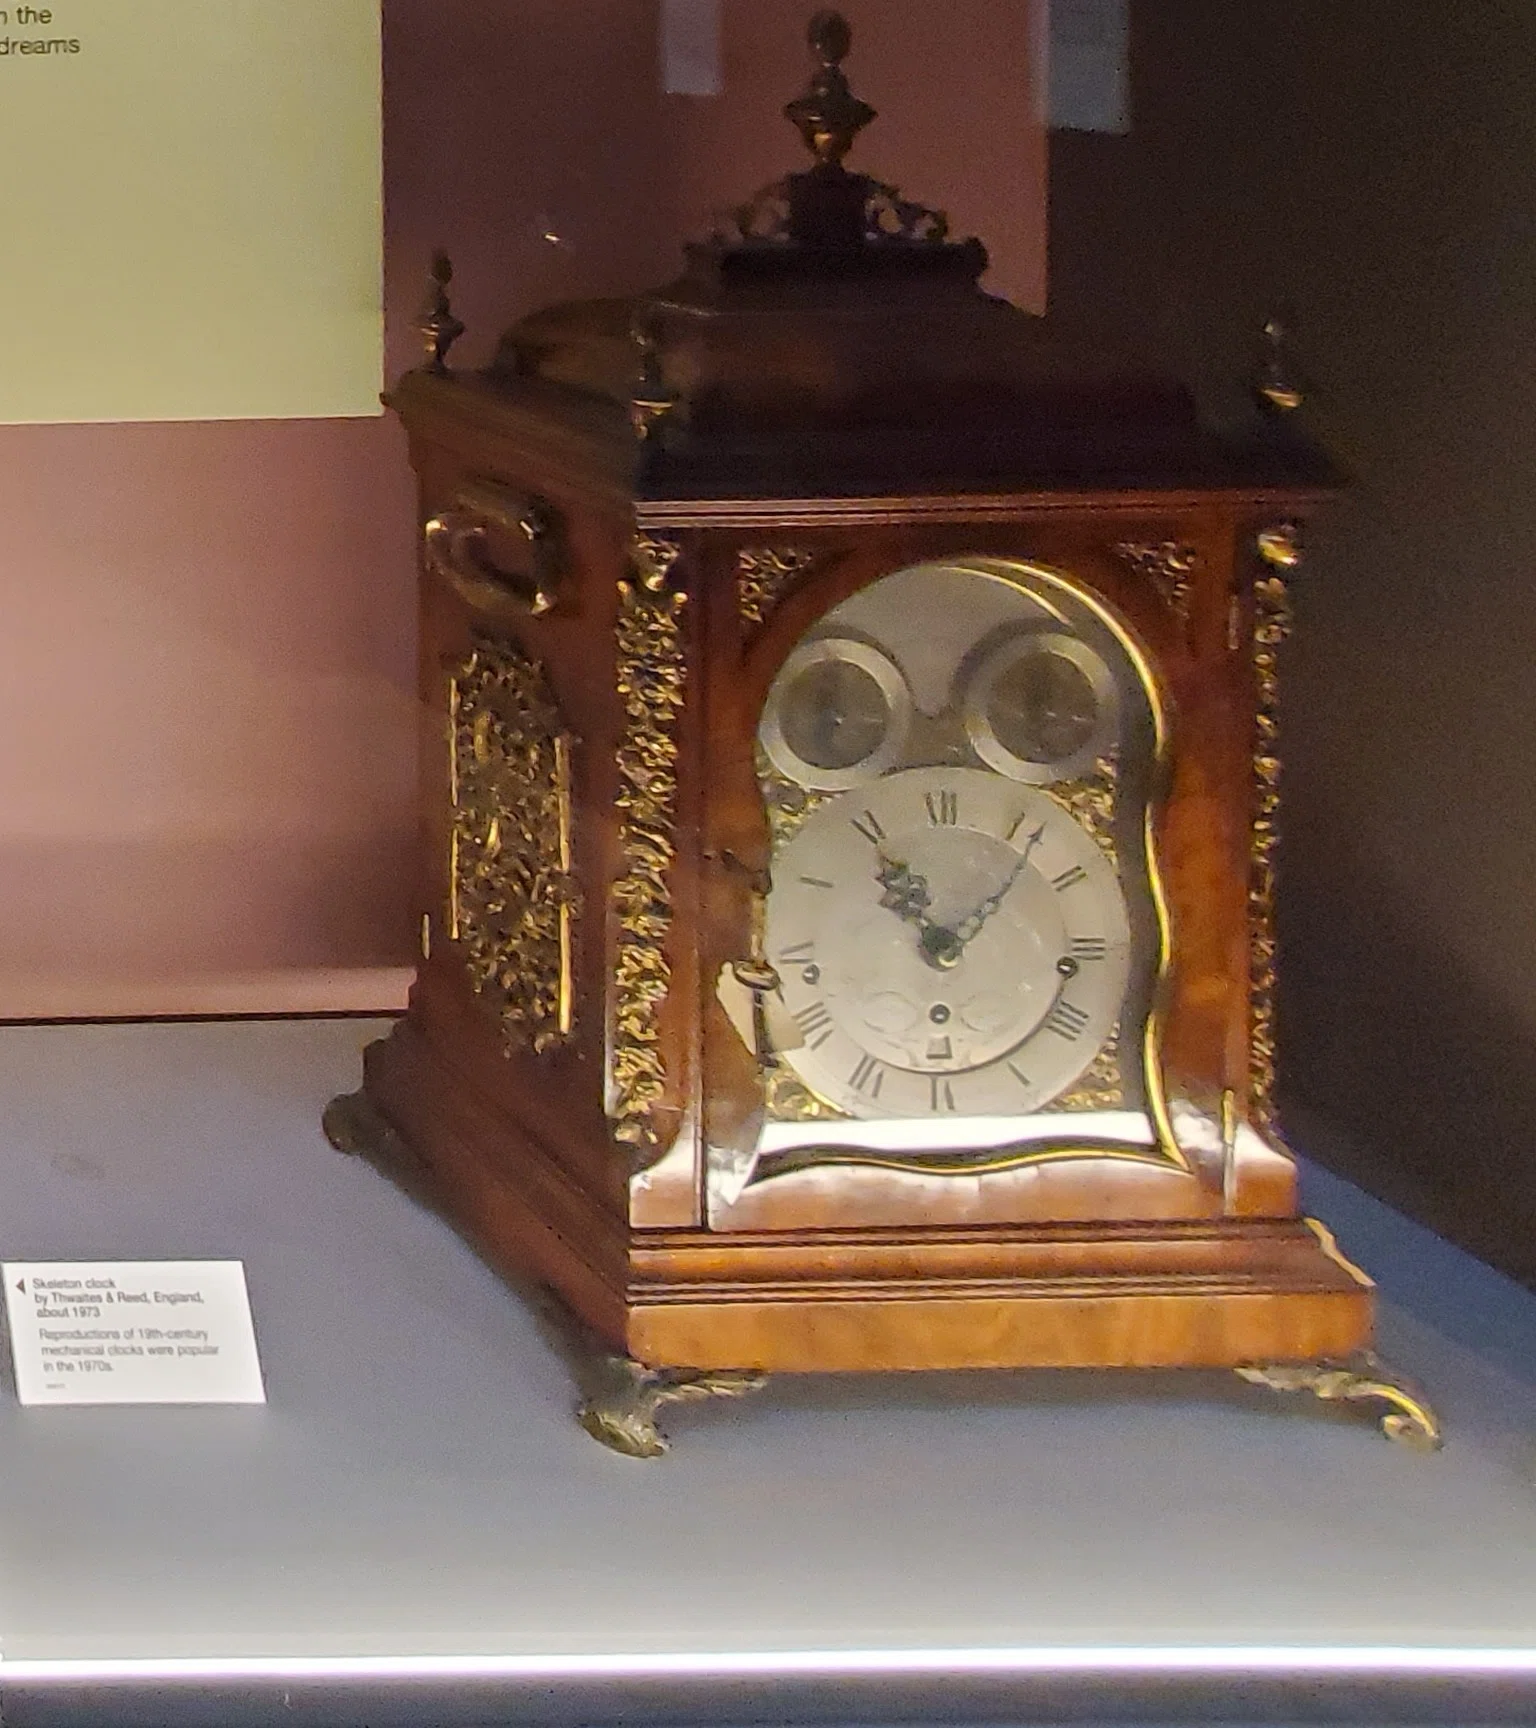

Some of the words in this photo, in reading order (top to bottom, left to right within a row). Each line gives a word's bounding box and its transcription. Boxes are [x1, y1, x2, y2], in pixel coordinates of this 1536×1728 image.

[17, 6, 53, 24] the
[86, 1277, 117, 1289] clock
[34, 1293, 48, 1307] by
[154, 1291, 205, 1304] England,
[37, 1307, 70, 1318] about
[123, 1328, 134, 1339] of
